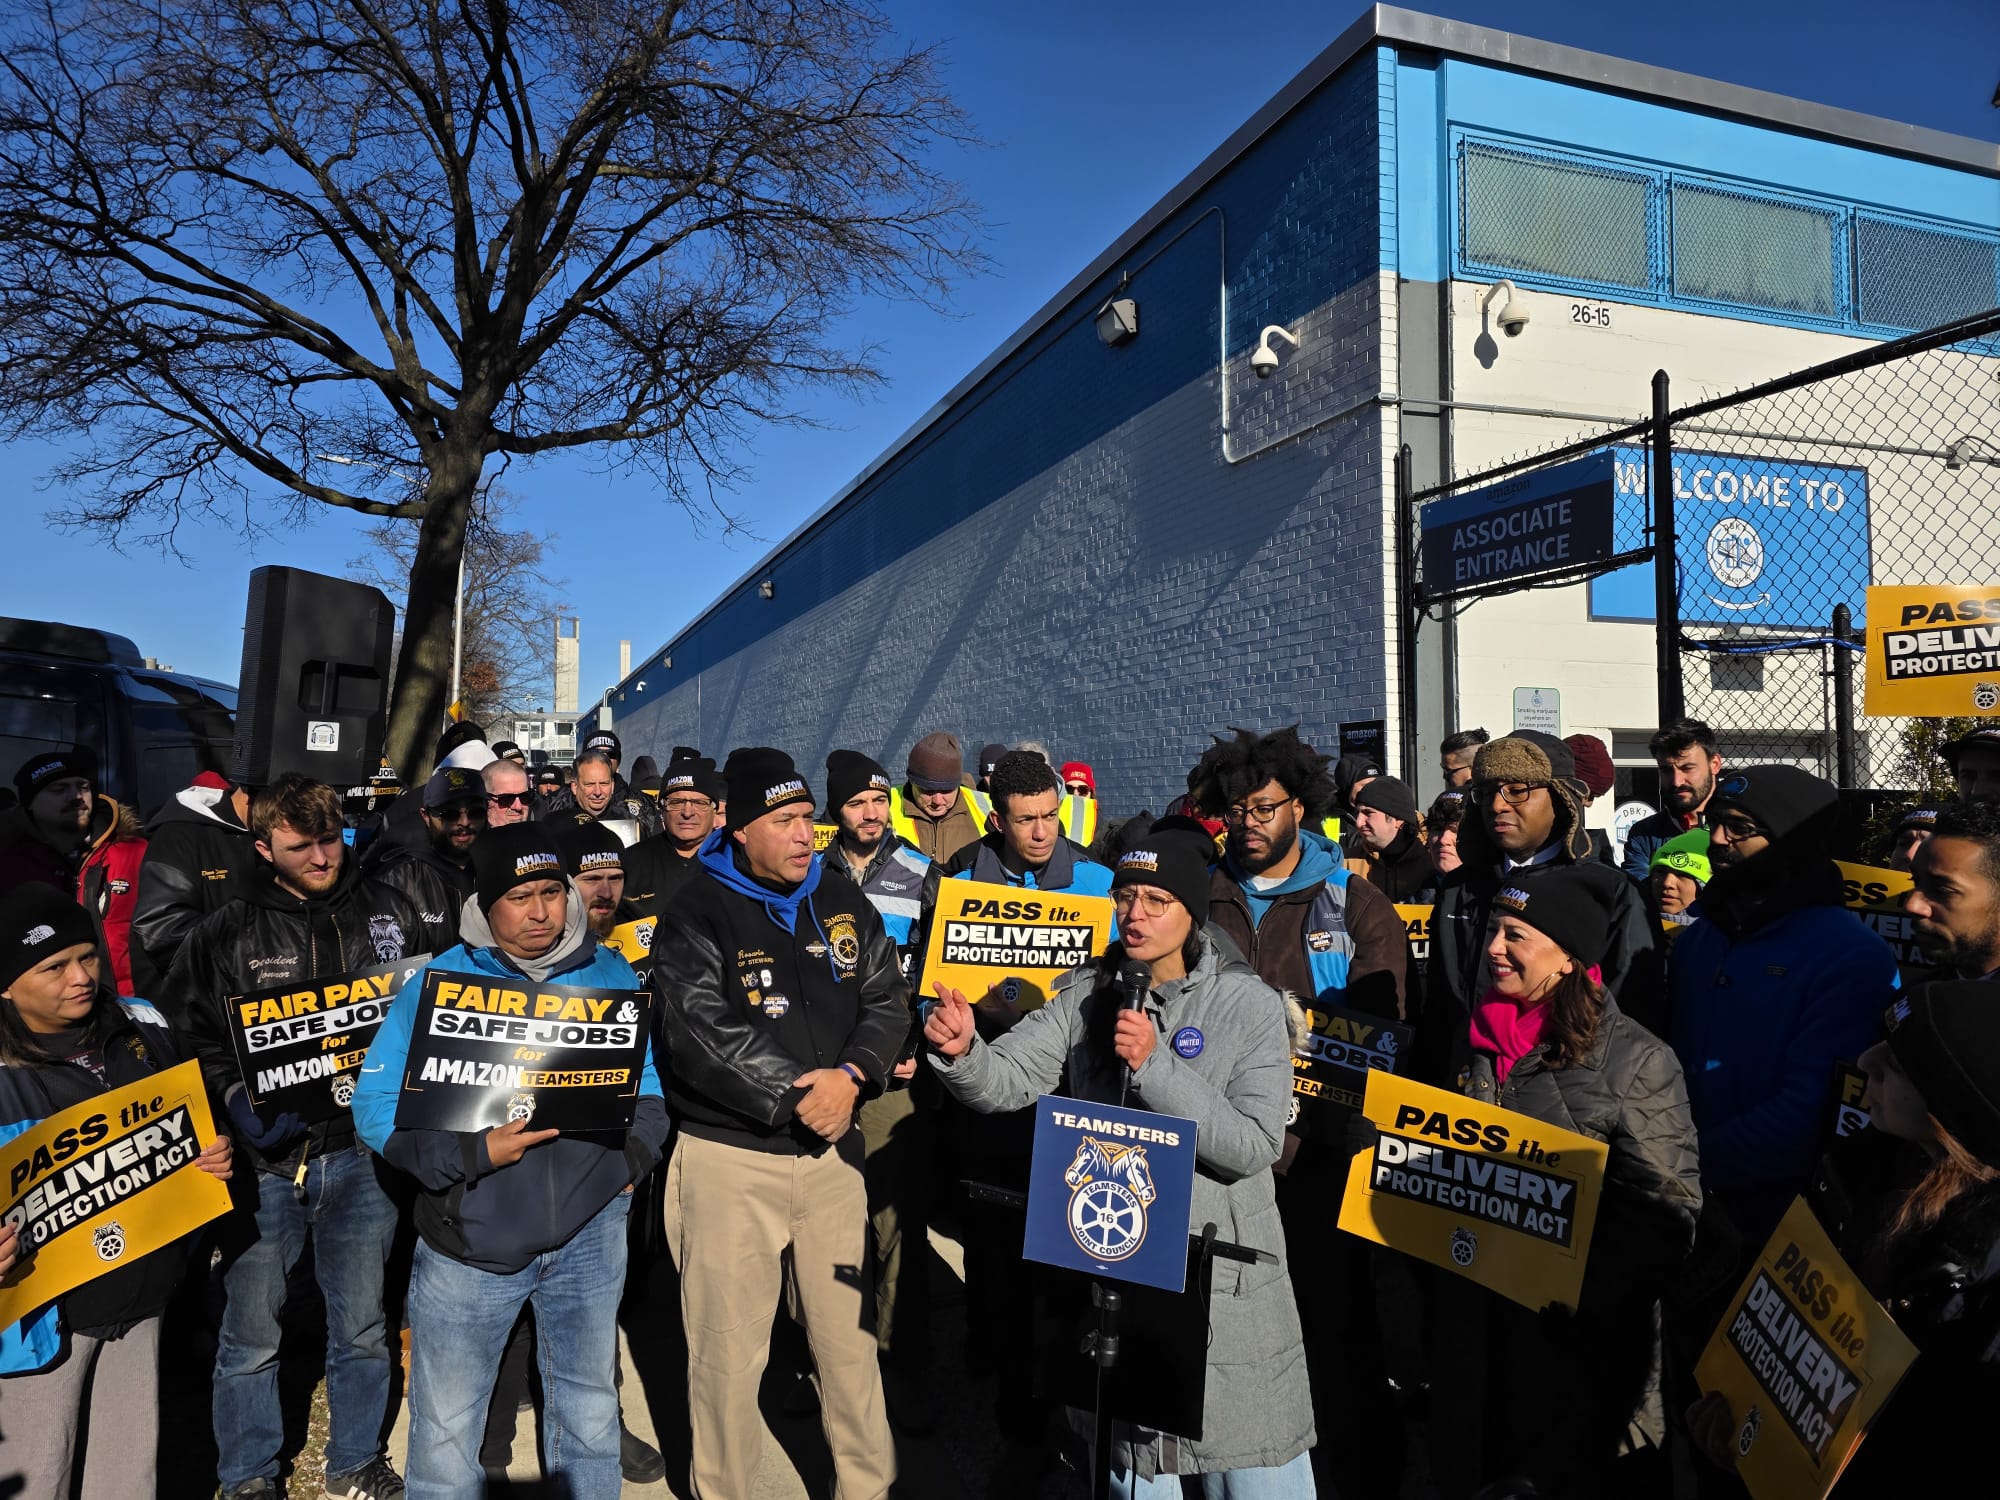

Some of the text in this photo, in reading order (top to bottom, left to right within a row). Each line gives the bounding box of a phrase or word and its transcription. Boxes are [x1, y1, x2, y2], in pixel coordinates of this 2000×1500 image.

[1571, 304, 1610, 326] 26-15
[1487, 479, 1530, 500] amazon
[1614, 461, 1846, 512] WLCOME TO
[1453, 499, 1573, 551] ASSOCIATE
[1455, 534, 1570, 581] ENTRANCE
[1346, 729, 1377, 740] amazon
[765, 780, 804, 800] AMAZON
[766, 788, 807, 805] TEAMSTERS
[1623, 807, 1647, 817] DBK7
[516, 853, 558, 868] AMAZON
[580, 861, 621, 871] TEAMSTERS
[581, 852, 619, 865] AMAZON
[880, 880, 907, 890] amazon
[960, 899, 1081, 922] PASS the
[947, 923, 1091, 948] DELIVERY
[946, 945, 1089, 965] PROTECTION ACT
[239, 993, 319, 1027] FAIR
[324, 972, 395, 1008] PAY
[434, 981, 640, 1023] FAIR PAY &
[250, 1016, 326, 1048] SAFE
[321, 1035, 350, 1050] for
[435, 1013, 632, 1045] SAFE JOBS
[1180, 1038, 1200, 1047] UNITED
[1306, 1009, 1399, 1053] PAY &
[513, 1046, 548, 1062] for
[257, 1053, 338, 1093] AMAZON
[420, 1057, 625, 1088] AMAZON TEAMSTERS
[1052, 1111, 1180, 1146] TEAMSTERS
[1395, 1104, 1561, 1169] PASS the
[10, 1096, 164, 1198] PASS the
[4, 1110, 185, 1236] DELIVERY
[1378, 1135, 1573, 1210] DELIVERY
[18, 1137, 194, 1256] ROTECTION ACT
[1084, 1182, 1137, 1208] TEAMSTERS
[1376, 1165, 1568, 1240] PROTECTION ACT
[1100, 1212, 1114, 1224] 16
[1075, 1225, 1137, 1255] JOINT COUNCIL
[1774, 1241, 1865, 1358] PASS the
[1746, 1275, 1857, 1416] DELIVERY
[1731, 1310, 1833, 1454] PROTECTION ACT
